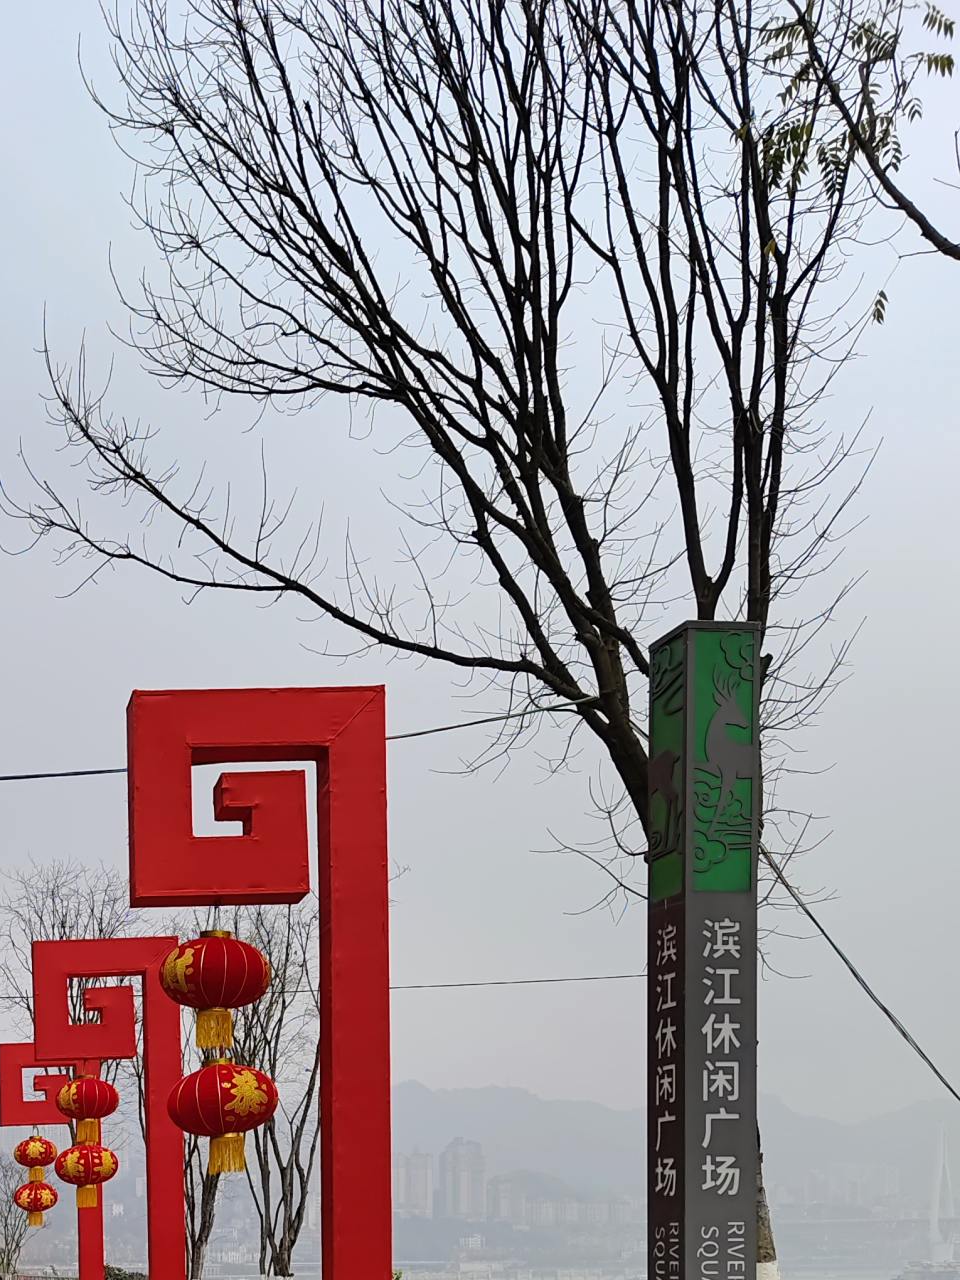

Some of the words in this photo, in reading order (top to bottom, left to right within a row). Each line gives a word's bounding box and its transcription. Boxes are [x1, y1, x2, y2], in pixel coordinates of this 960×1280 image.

[655, 924, 677, 1197] 滨江休闲广场
[700, 917, 742, 1197] 滨江休闲广场
